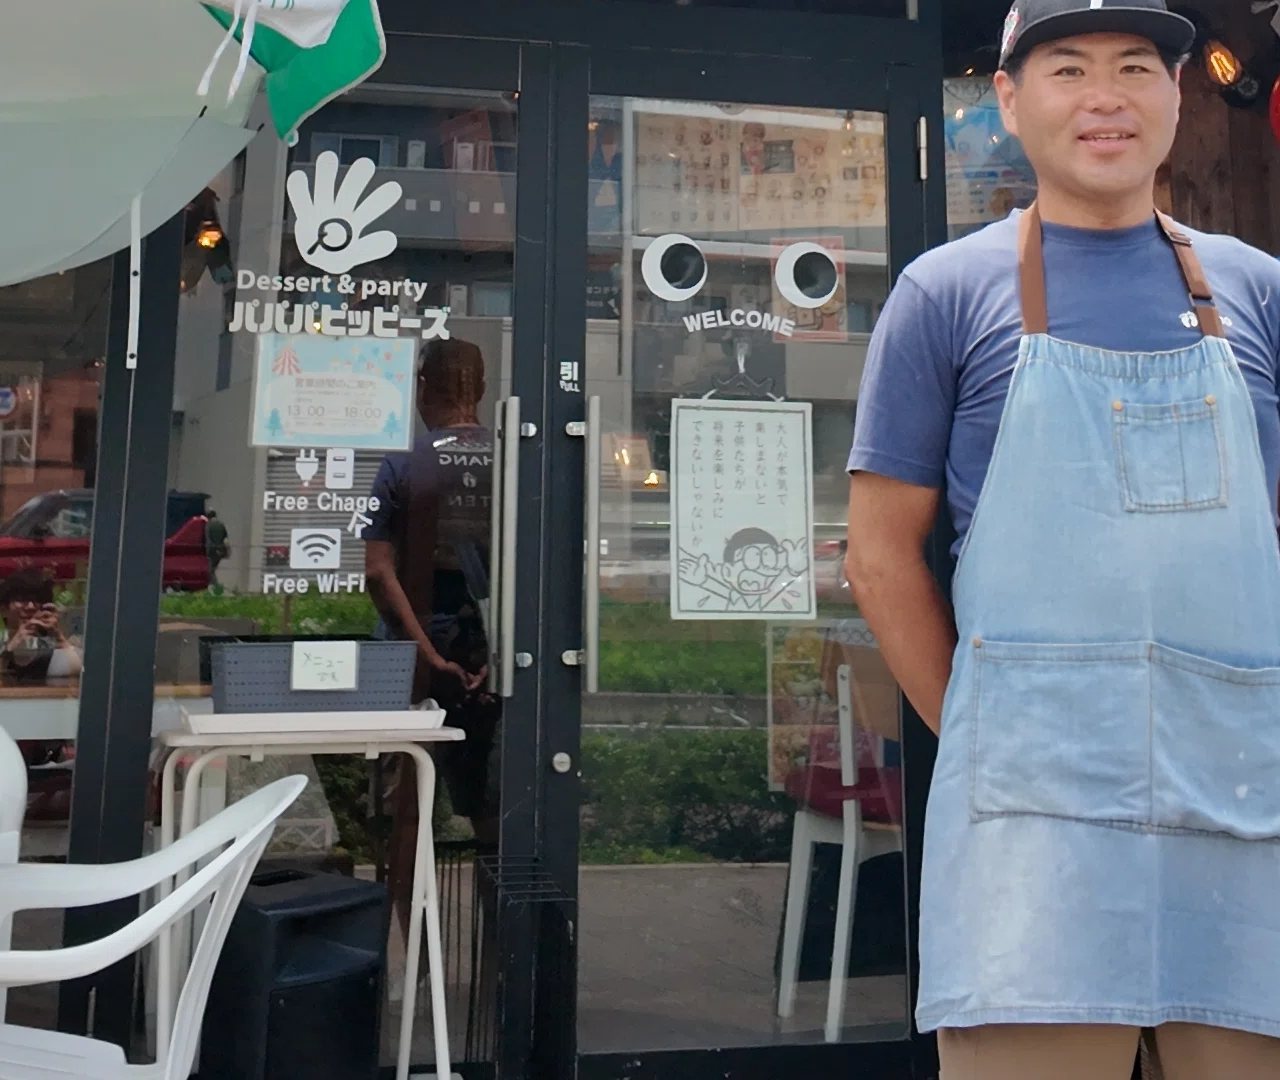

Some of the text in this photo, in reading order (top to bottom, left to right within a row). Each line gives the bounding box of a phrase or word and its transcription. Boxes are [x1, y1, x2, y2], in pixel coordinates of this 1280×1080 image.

[236, 269, 428, 302] Dessert & party
[683, 308, 796, 337] WELCOME
[560, 361, 579, 381] 引
[559, 379, 580, 393] PULL
[263, 491, 380, 513] Free Chage
[263, 574, 365, 594] Free Wi-Fi
